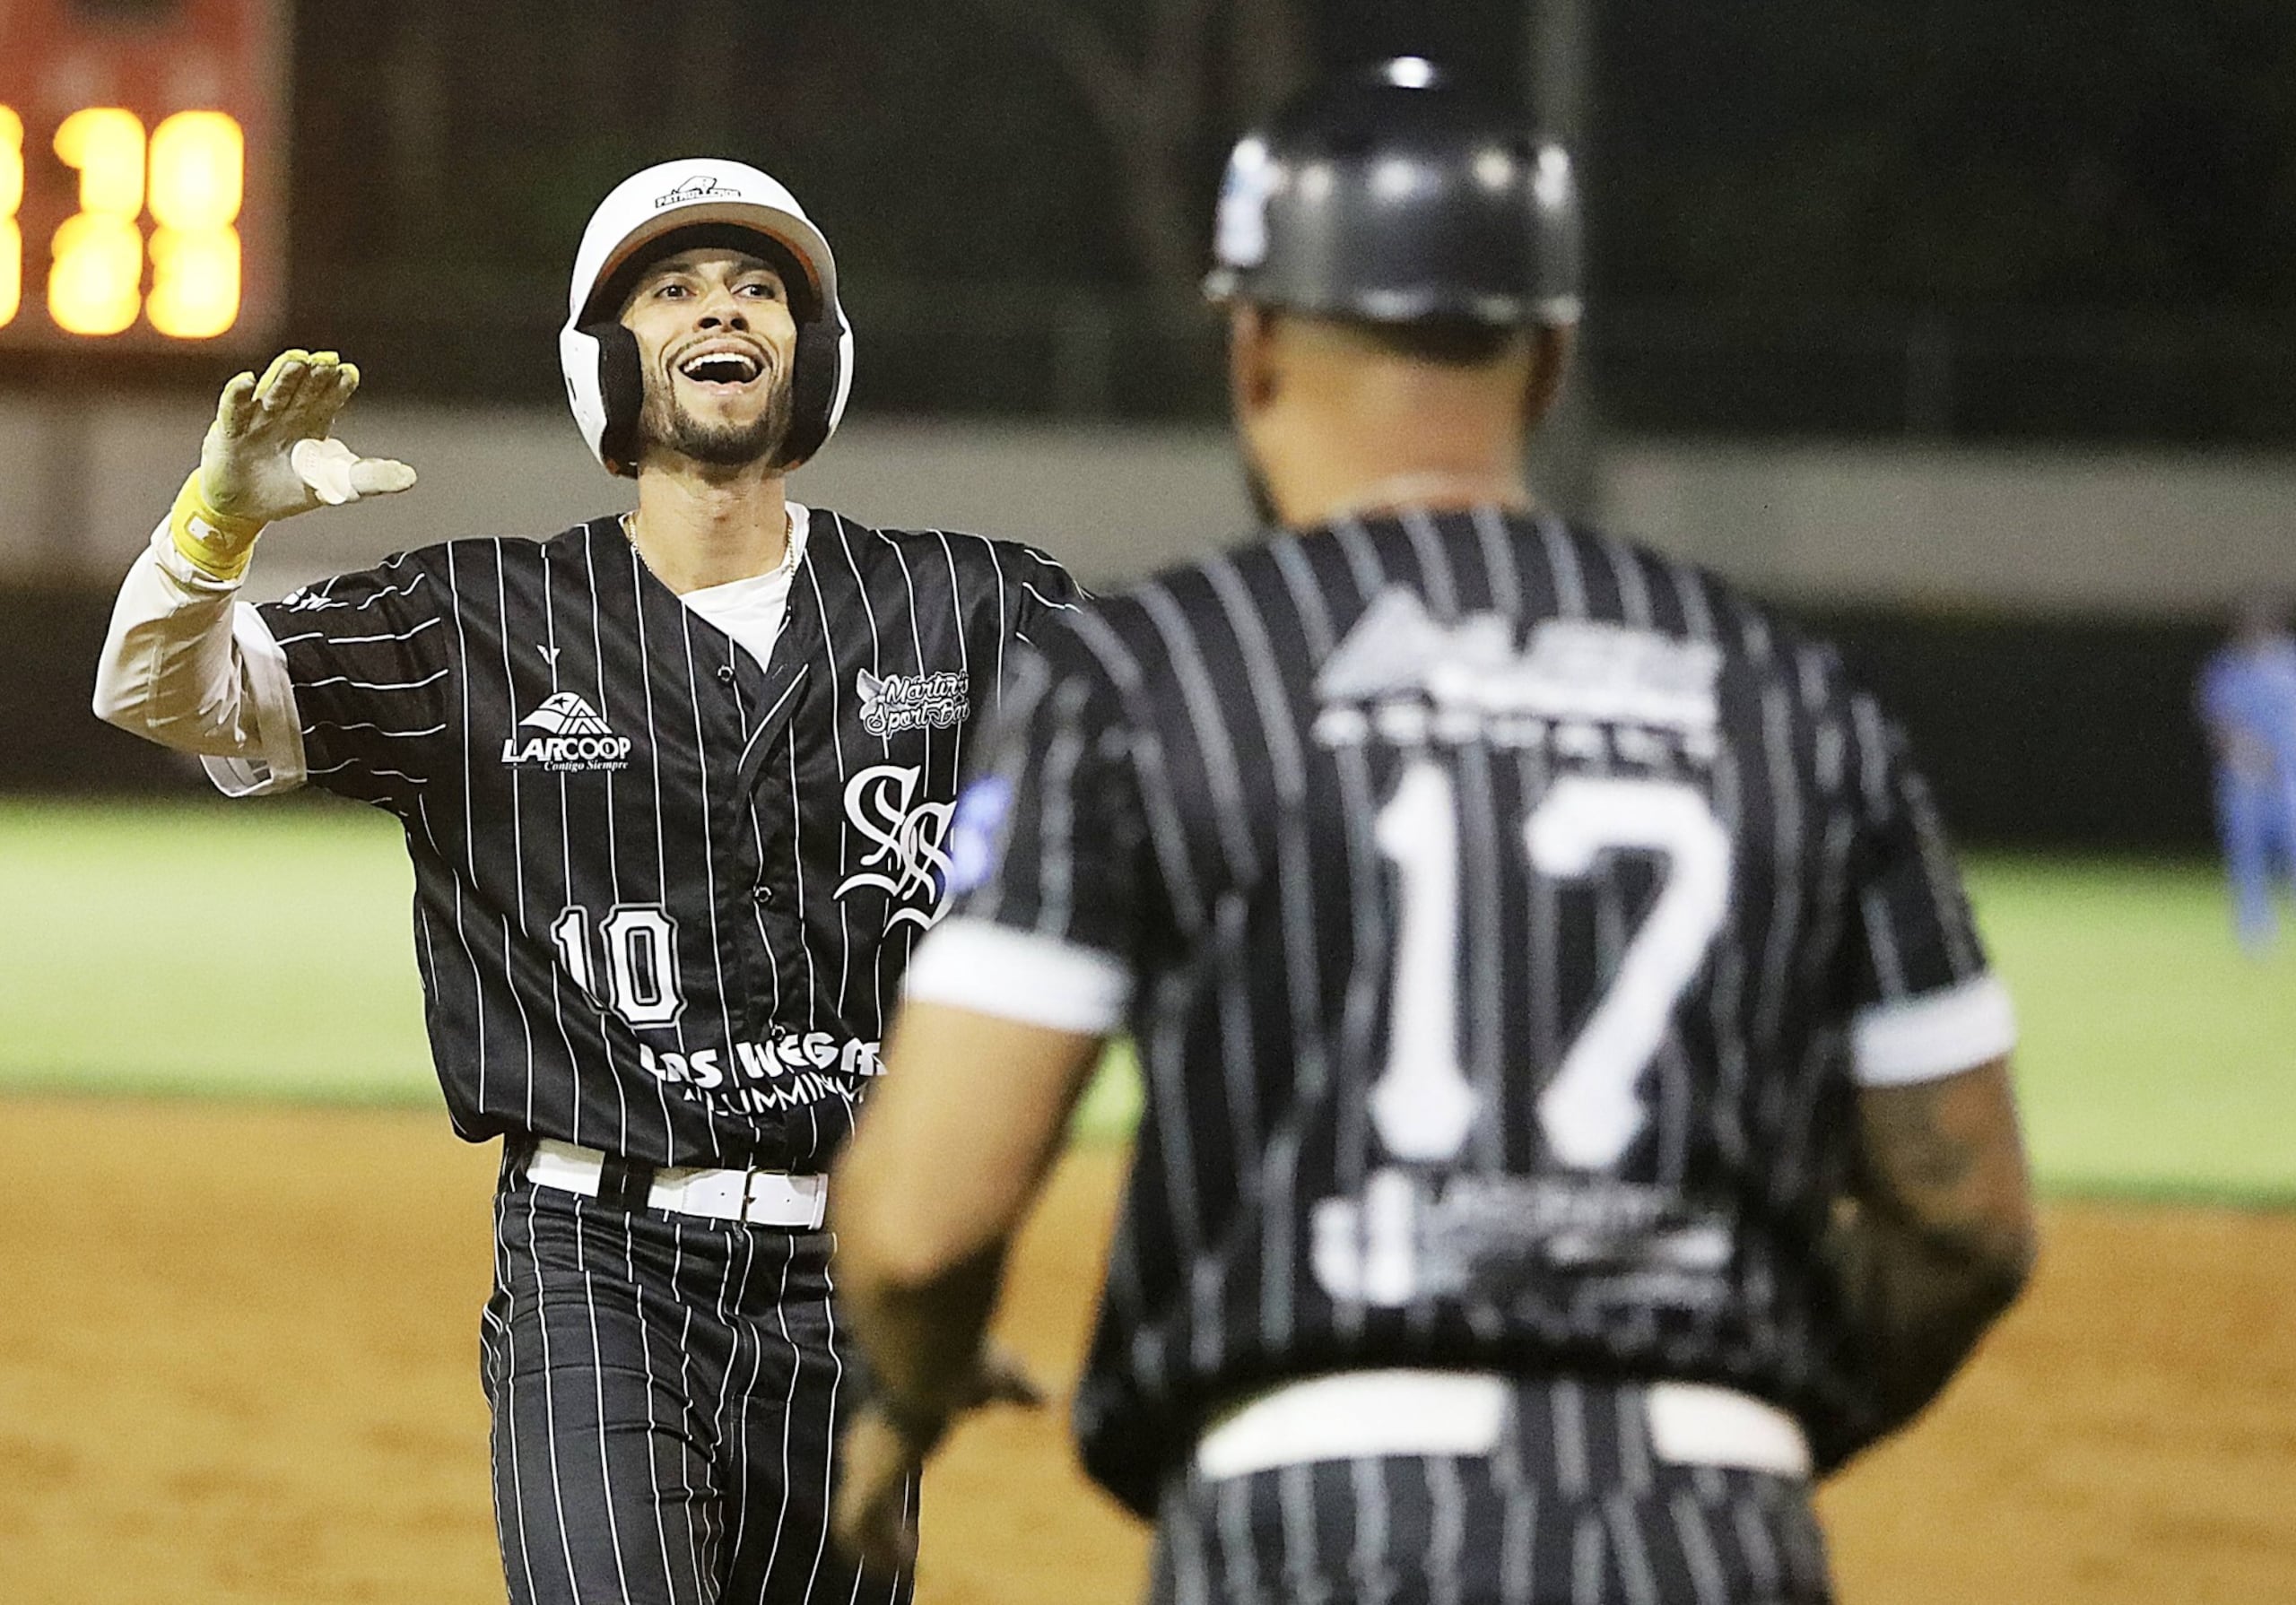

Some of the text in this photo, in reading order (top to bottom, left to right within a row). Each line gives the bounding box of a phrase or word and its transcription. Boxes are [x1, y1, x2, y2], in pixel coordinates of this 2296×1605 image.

[866, 700, 929, 737] Sport
[501, 737, 631, 762] LARCOOP
[544, 759, 629, 773] Contigo Siempre
[550, 902, 688, 1029] 10
[1372, 761, 1731, 1168] 17
[639, 1043, 723, 1089] LAS
